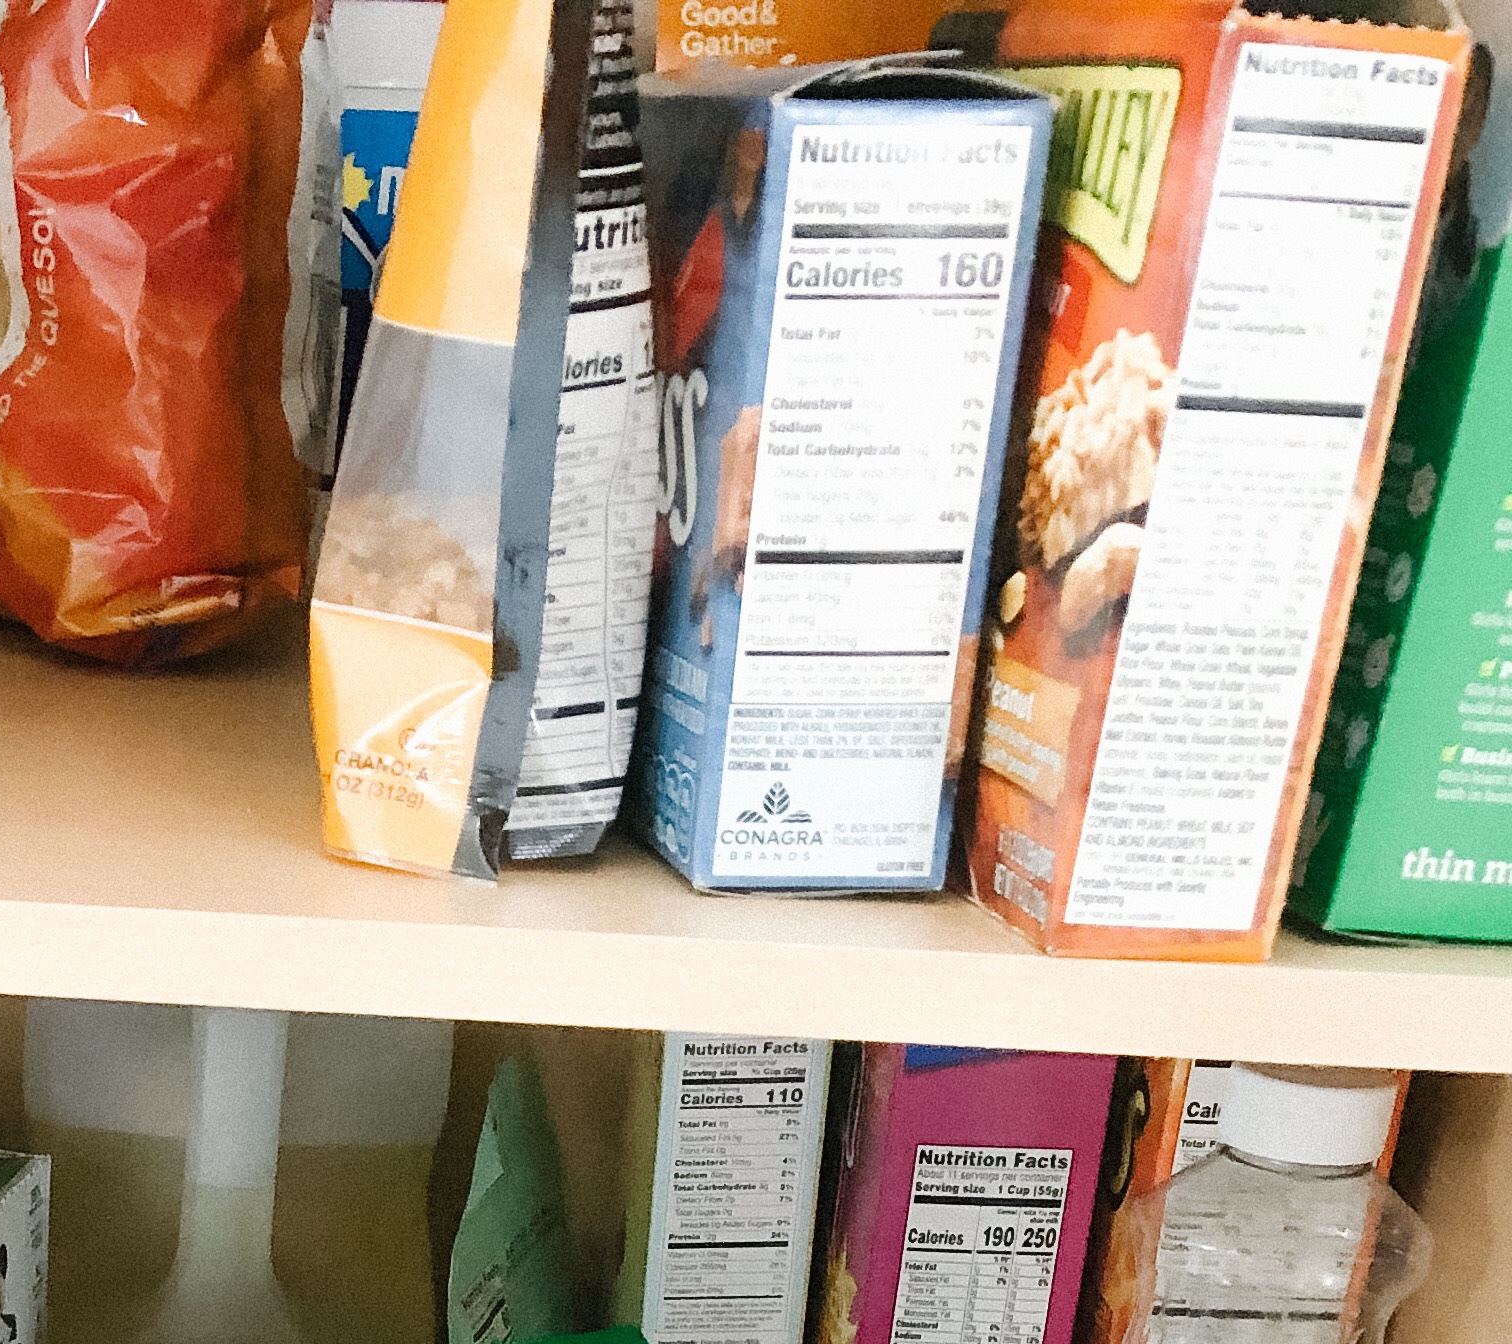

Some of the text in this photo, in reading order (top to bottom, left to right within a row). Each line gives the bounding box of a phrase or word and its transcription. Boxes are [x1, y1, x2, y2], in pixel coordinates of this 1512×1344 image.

[679, 29, 779, 57] Gather
[1246, 50, 1439, 88] Nutrition Facts
[786, 253, 1006, 290] Calories 160
[12, 351, 49, 390] THE
[335, 776, 363, 795] OZ
[720, 829, 825, 847] CONAGRA
[1401, 846, 1475, 881] thin
[684, 1041, 809, 1057] Nutrition Facts
[682, 1068, 717, 1079] Serving
[680, 1087, 804, 1106] Calories 110
[918, 1149, 1069, 1170] Nutrition Facts
[915, 1181, 1030, 1197] Serving size Cup
[907, 1226, 1058, 1248] Calories 190 250
